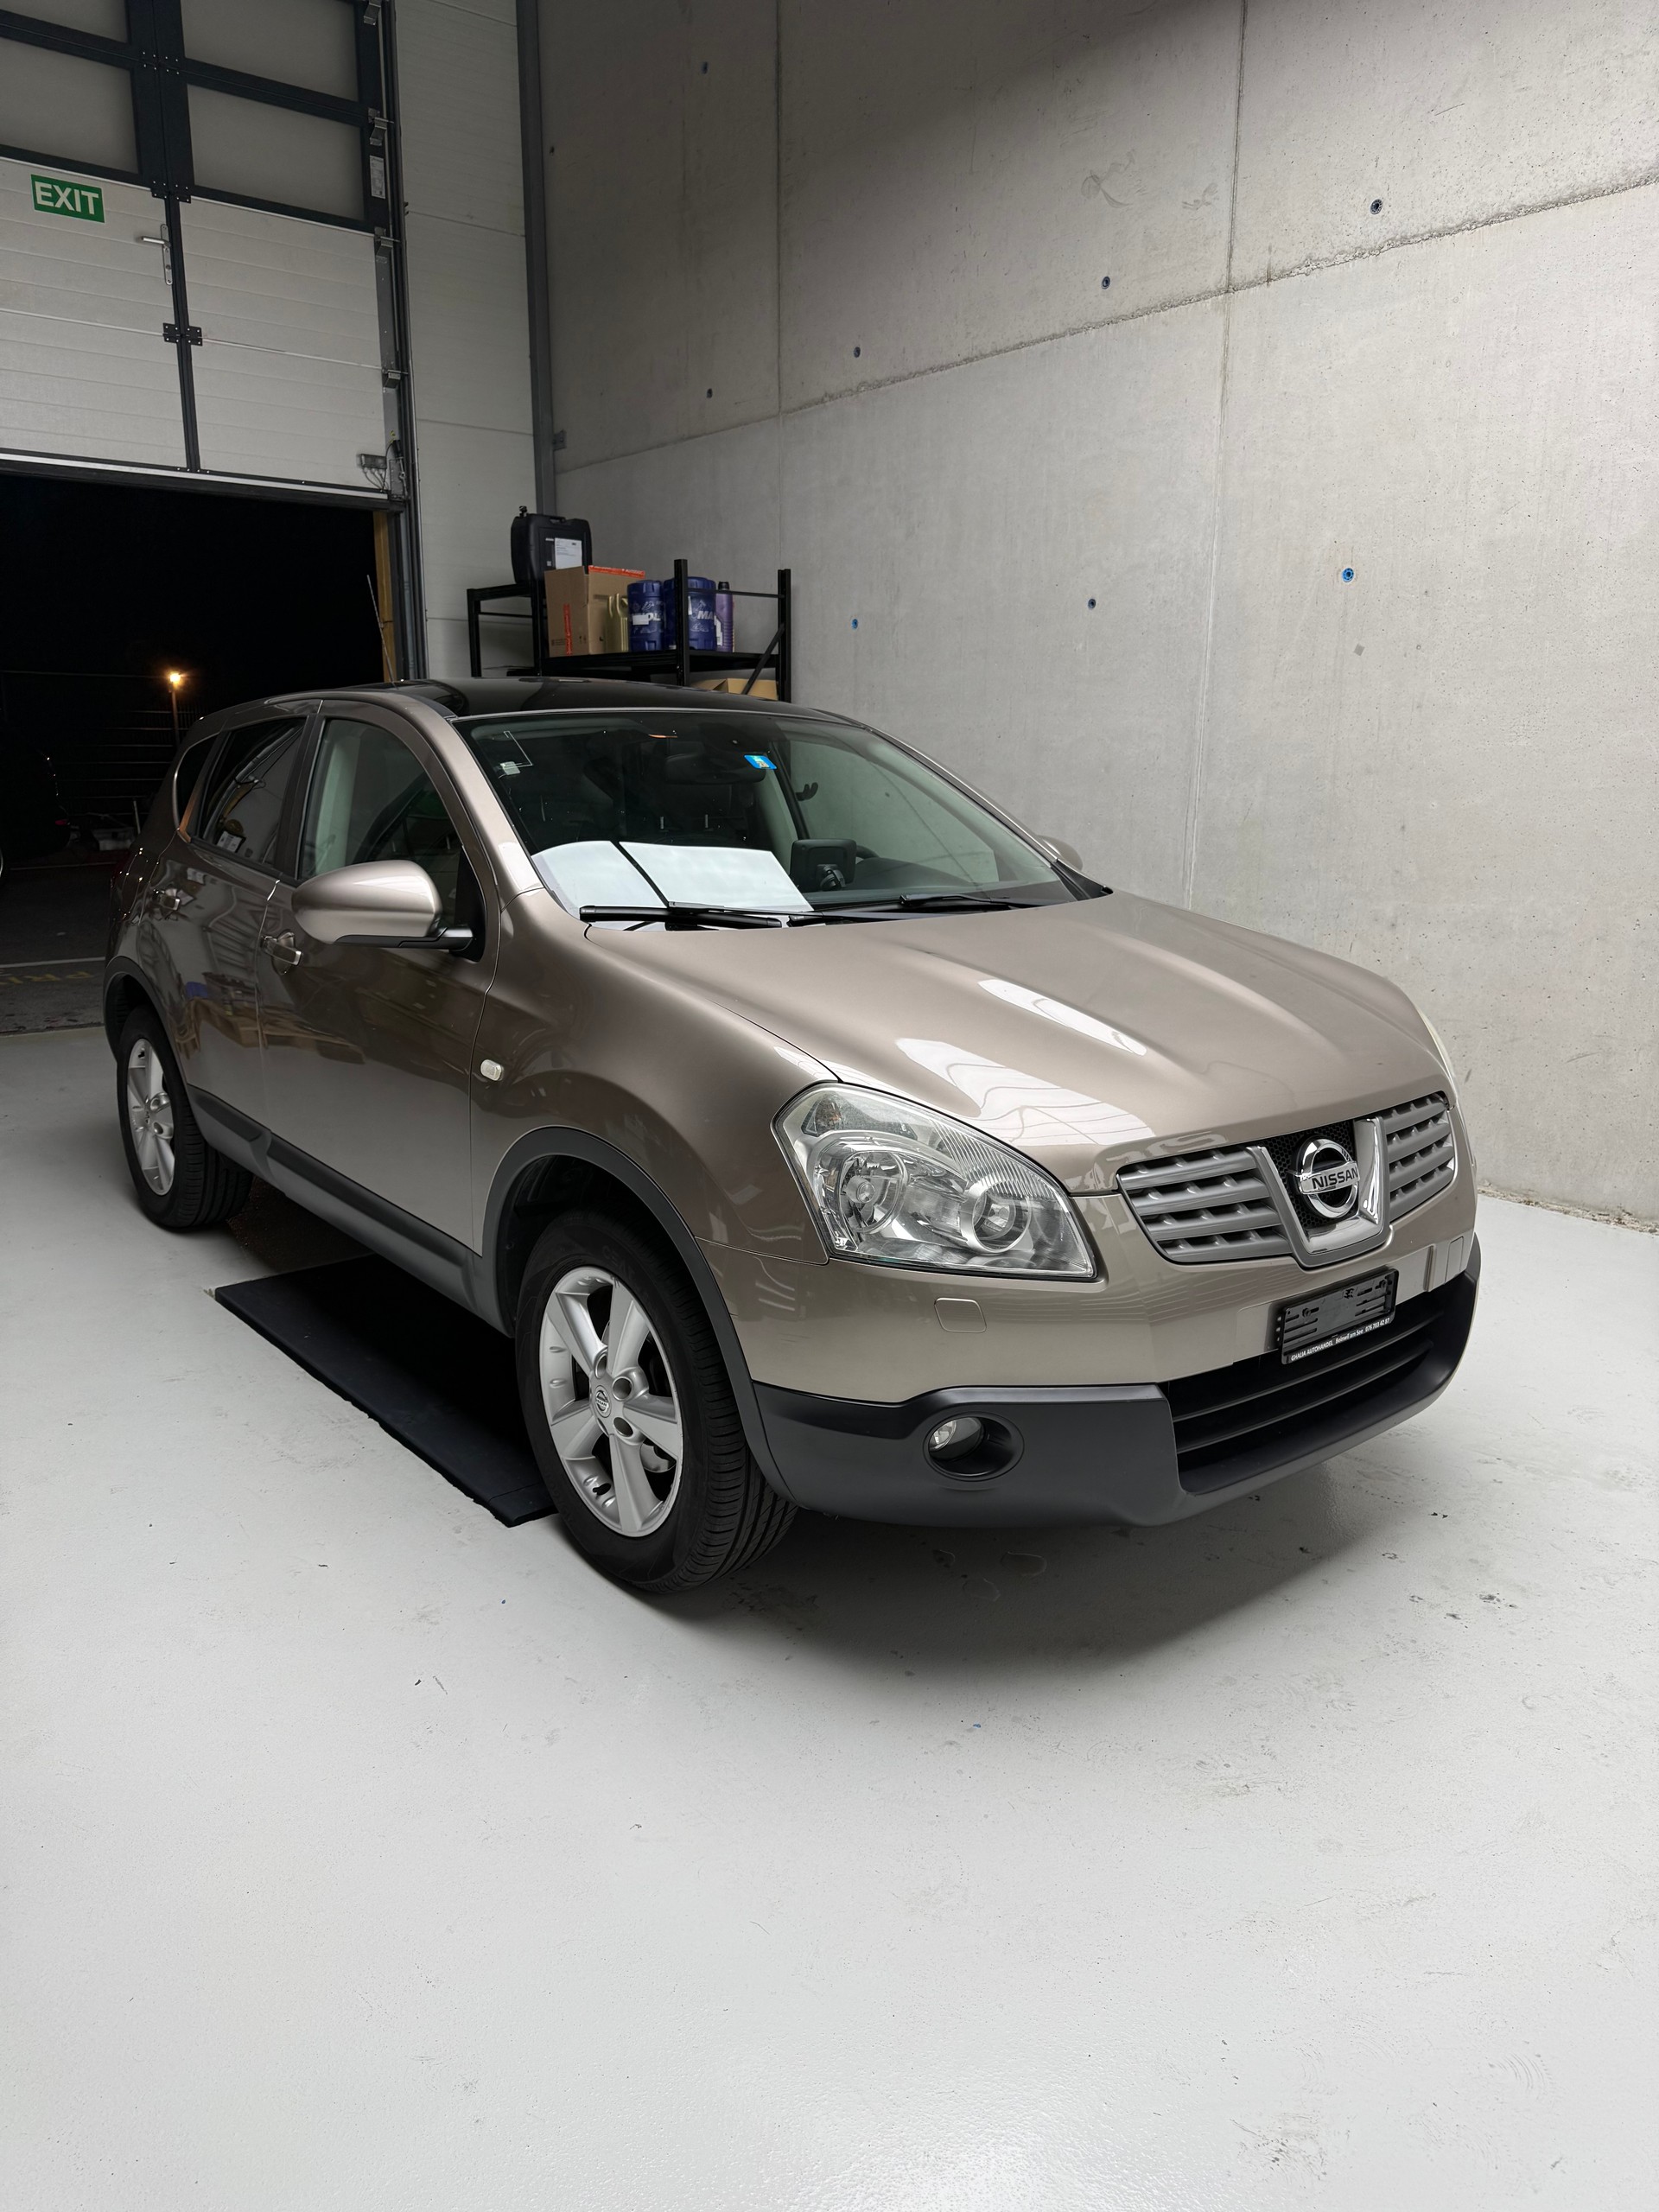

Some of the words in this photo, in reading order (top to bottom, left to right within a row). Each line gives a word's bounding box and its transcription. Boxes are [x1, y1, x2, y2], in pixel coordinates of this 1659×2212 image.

[35, 181, 99, 215] EXIT
[1312, 1168, 1358, 1189] NISSAN
[1306, 1340, 1333, 1356] AUTOHANDEL
